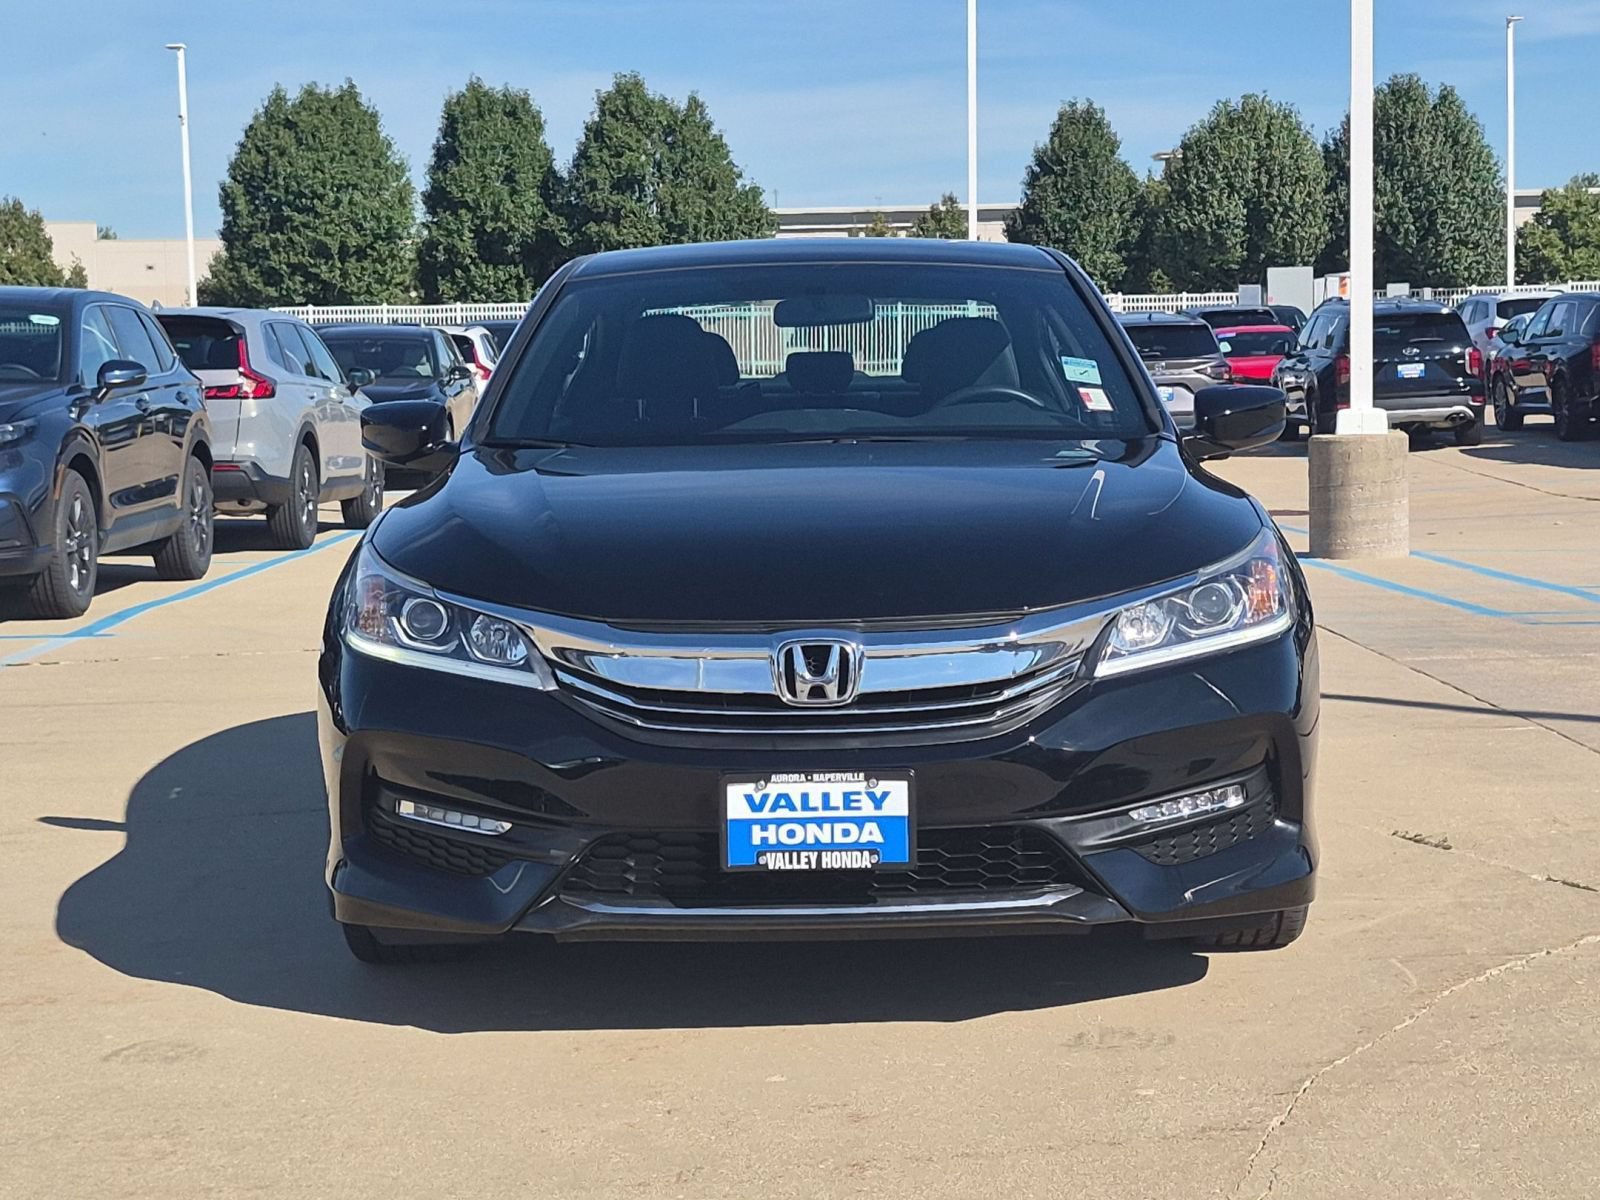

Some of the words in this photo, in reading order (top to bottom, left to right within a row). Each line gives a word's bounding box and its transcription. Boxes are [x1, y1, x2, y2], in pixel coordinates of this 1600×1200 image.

[771, 773, 806, 782] AURORA
[812, 772, 865, 782] NAPERVILLE
[743, 791, 892, 813] VALLEY
[752, 822, 885, 845] HONDA
[766, 852, 817, 870] VALLEY
[821, 851, 872, 869] HONDA
